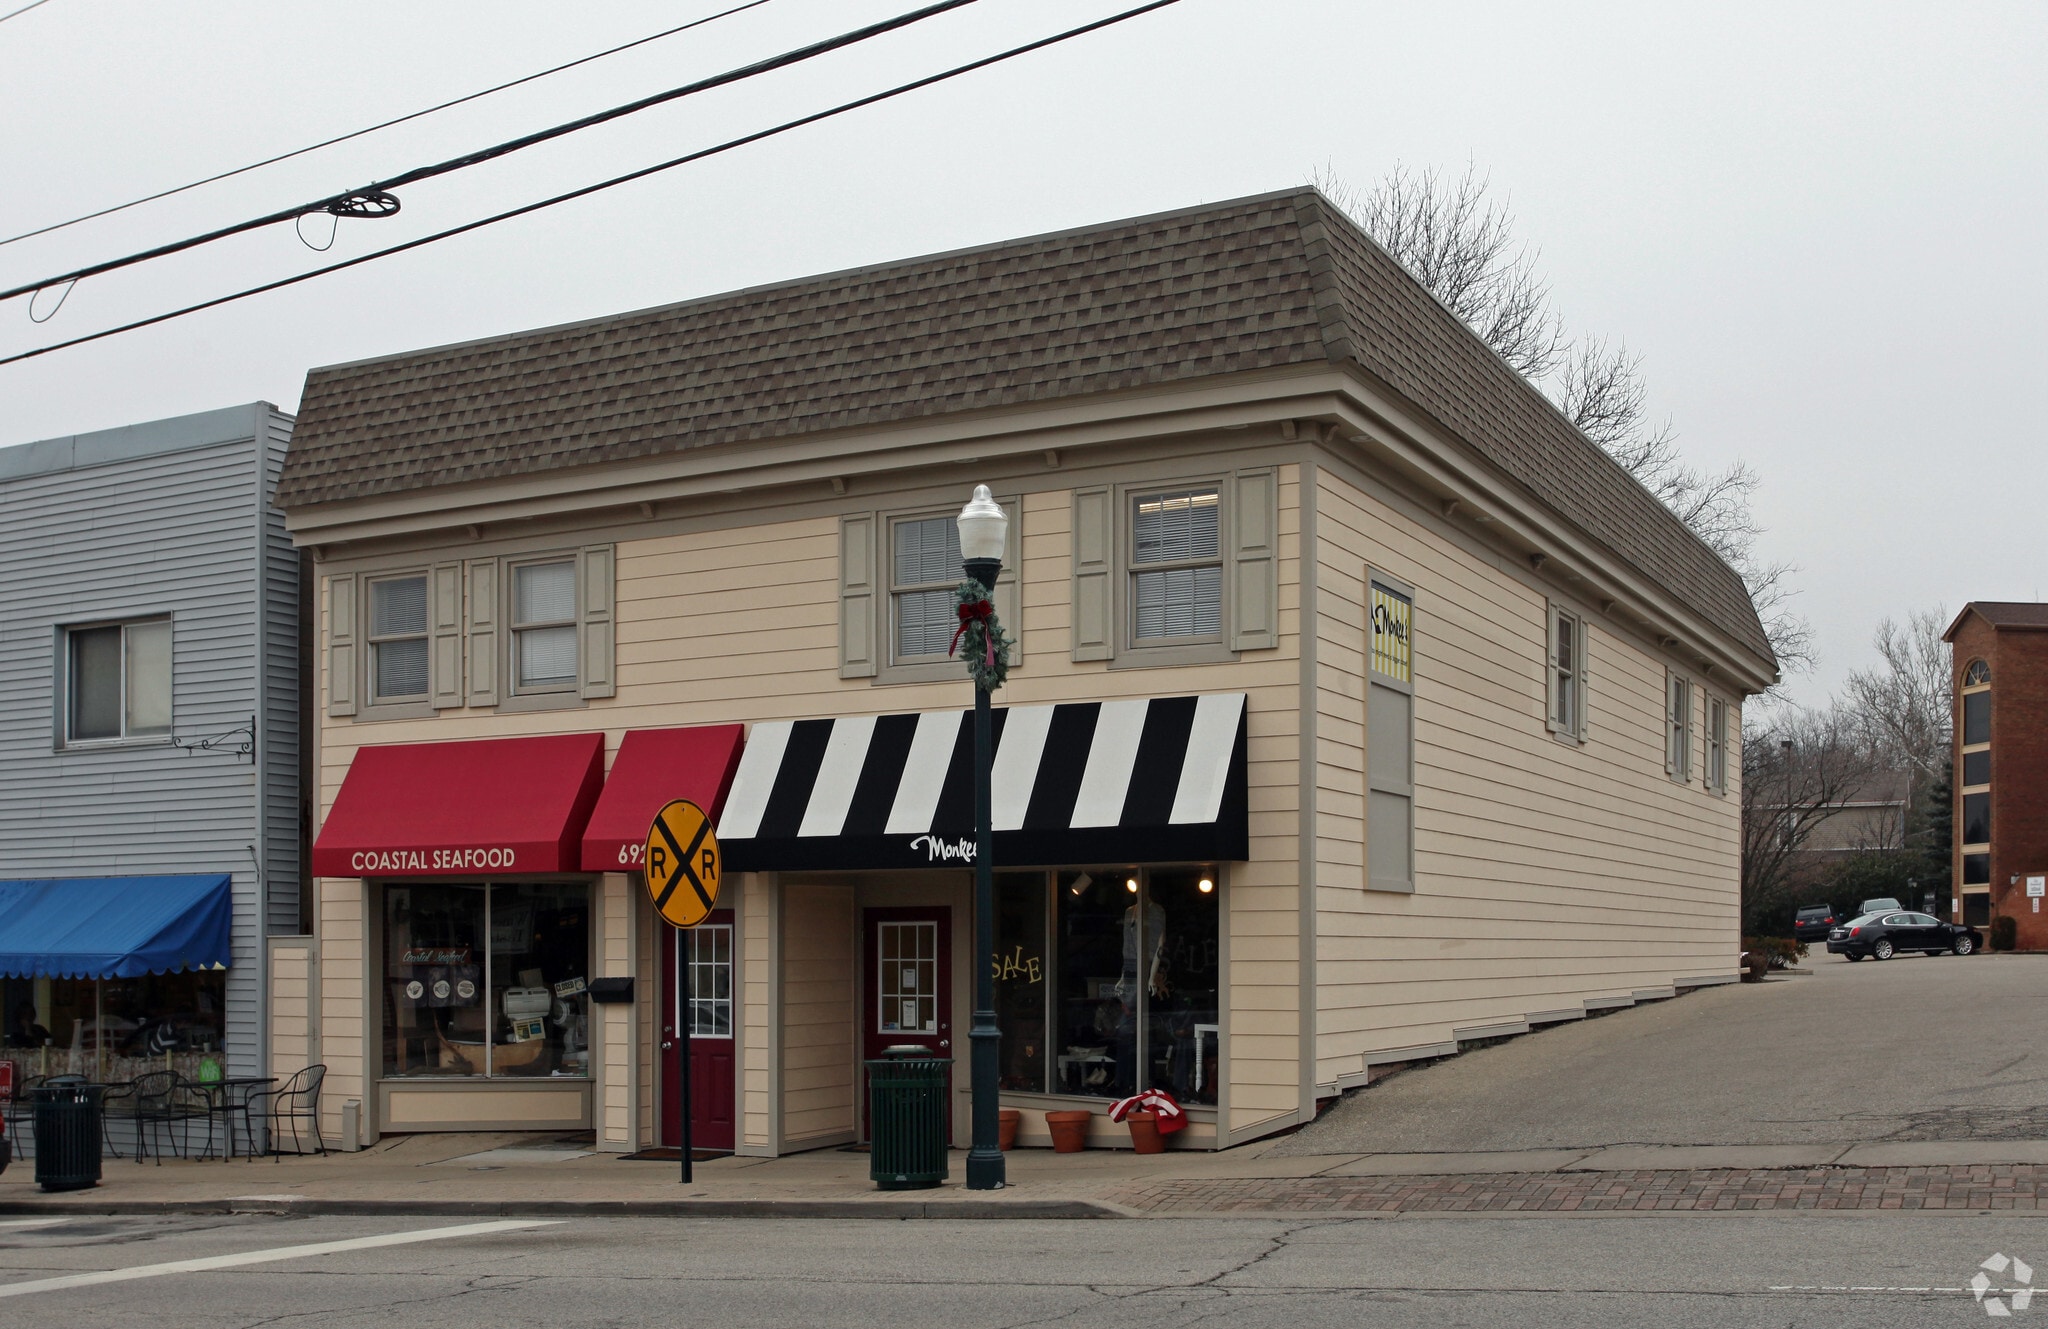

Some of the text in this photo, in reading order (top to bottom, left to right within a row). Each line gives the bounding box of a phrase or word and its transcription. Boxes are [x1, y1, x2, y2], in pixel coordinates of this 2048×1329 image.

[352, 848, 515, 870] COASTAL SEAFOOD
[651, 847, 667, 879] R
[701, 849, 716, 880] R
[403, 950, 468, 964] Coastal Seafood
[992, 945, 1042, 984] SALE
[556, 980, 575, 992] CLOSED
